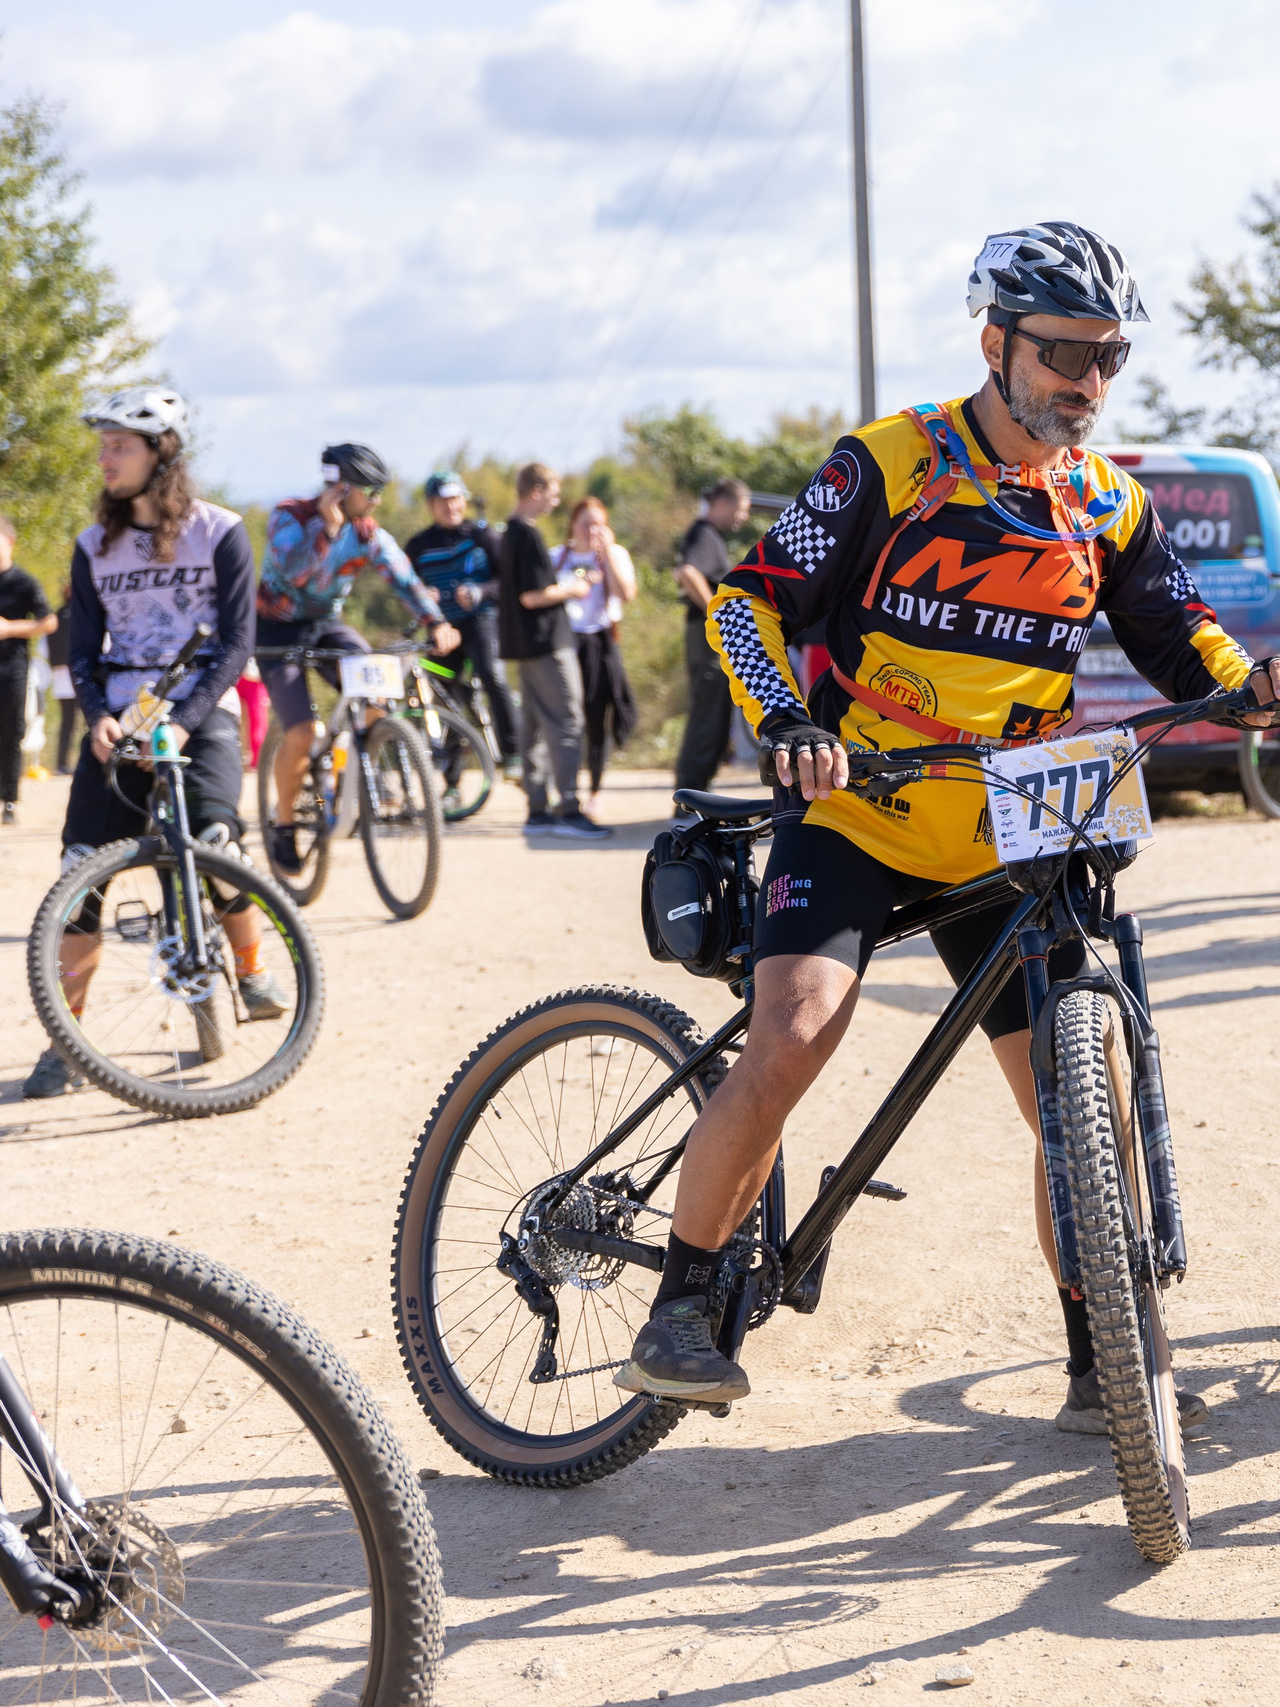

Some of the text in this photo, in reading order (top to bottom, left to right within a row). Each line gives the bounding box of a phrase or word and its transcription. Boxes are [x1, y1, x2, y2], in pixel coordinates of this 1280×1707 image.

[985, 243, 1013, 259] 777
[823, 464, 847, 491] MTB
[881, 586, 960, 631] LOVE
[974, 608, 1038, 644] THE
[884, 680, 921, 708] MTB
[1016, 760, 1110, 831] 777
[767, 874, 791, 893] KEEP
[767, 879, 812, 901] CYCLING
[765, 898, 808, 918] MOVING
[766, 891, 790, 910] KEEP
[31, 1268, 117, 1288] MINION
[406, 1296, 446, 1395] MAXXIS
